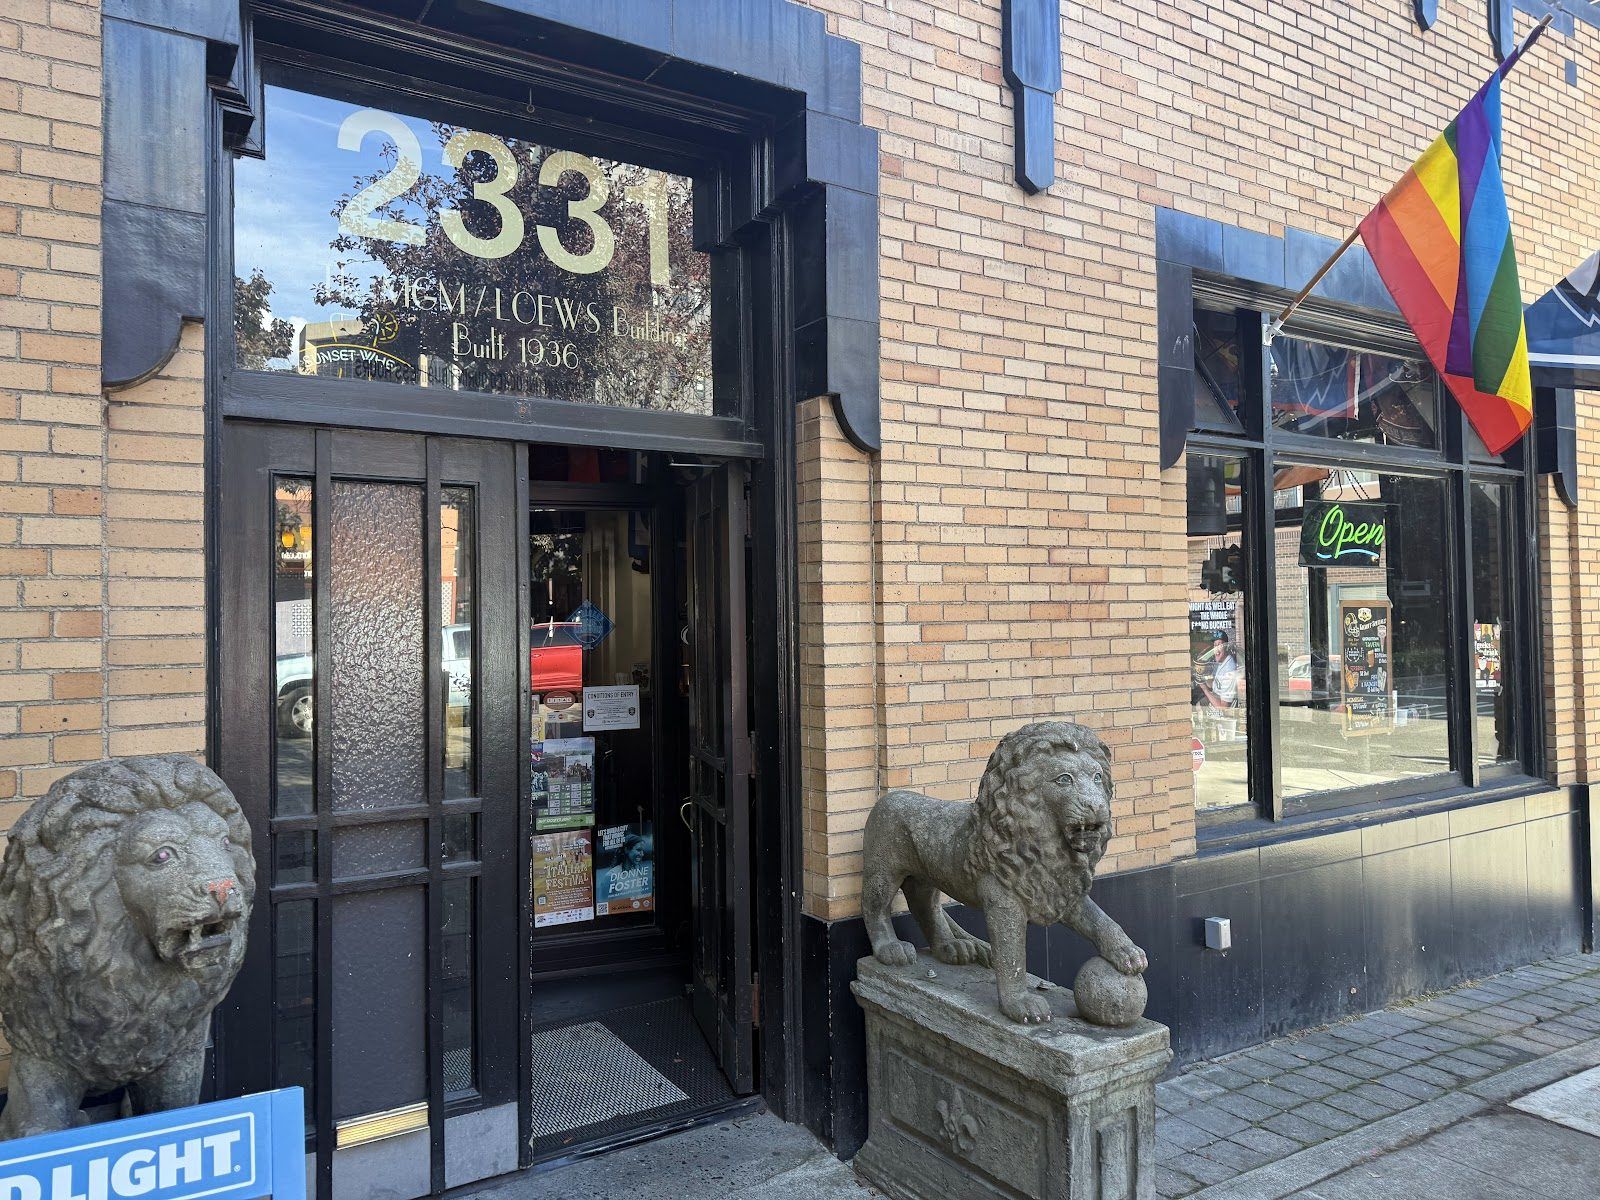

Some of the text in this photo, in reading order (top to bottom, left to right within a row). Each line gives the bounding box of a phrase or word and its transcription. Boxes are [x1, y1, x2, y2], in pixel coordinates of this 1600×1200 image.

[337, 107, 671, 286] 2331
[613, 305, 687, 352] Building
[453, 321, 579, 370] Built 1936
[1319, 504, 1386, 559] Open
[1200, 611, 1227, 620] THE WHOLE
[1205, 602, 1212, 610] AS
[1212, 602, 1226, 611] WELL
[1226, 601, 1235, 610] EAT
[543, 862, 588, 878] ITALIAN
[610, 866, 649, 882] DIONNE
[545, 872, 589, 891] FESTIVAL
[608, 876, 649, 894] FOSTER
[51, 1129, 241, 1200] LIGHT
